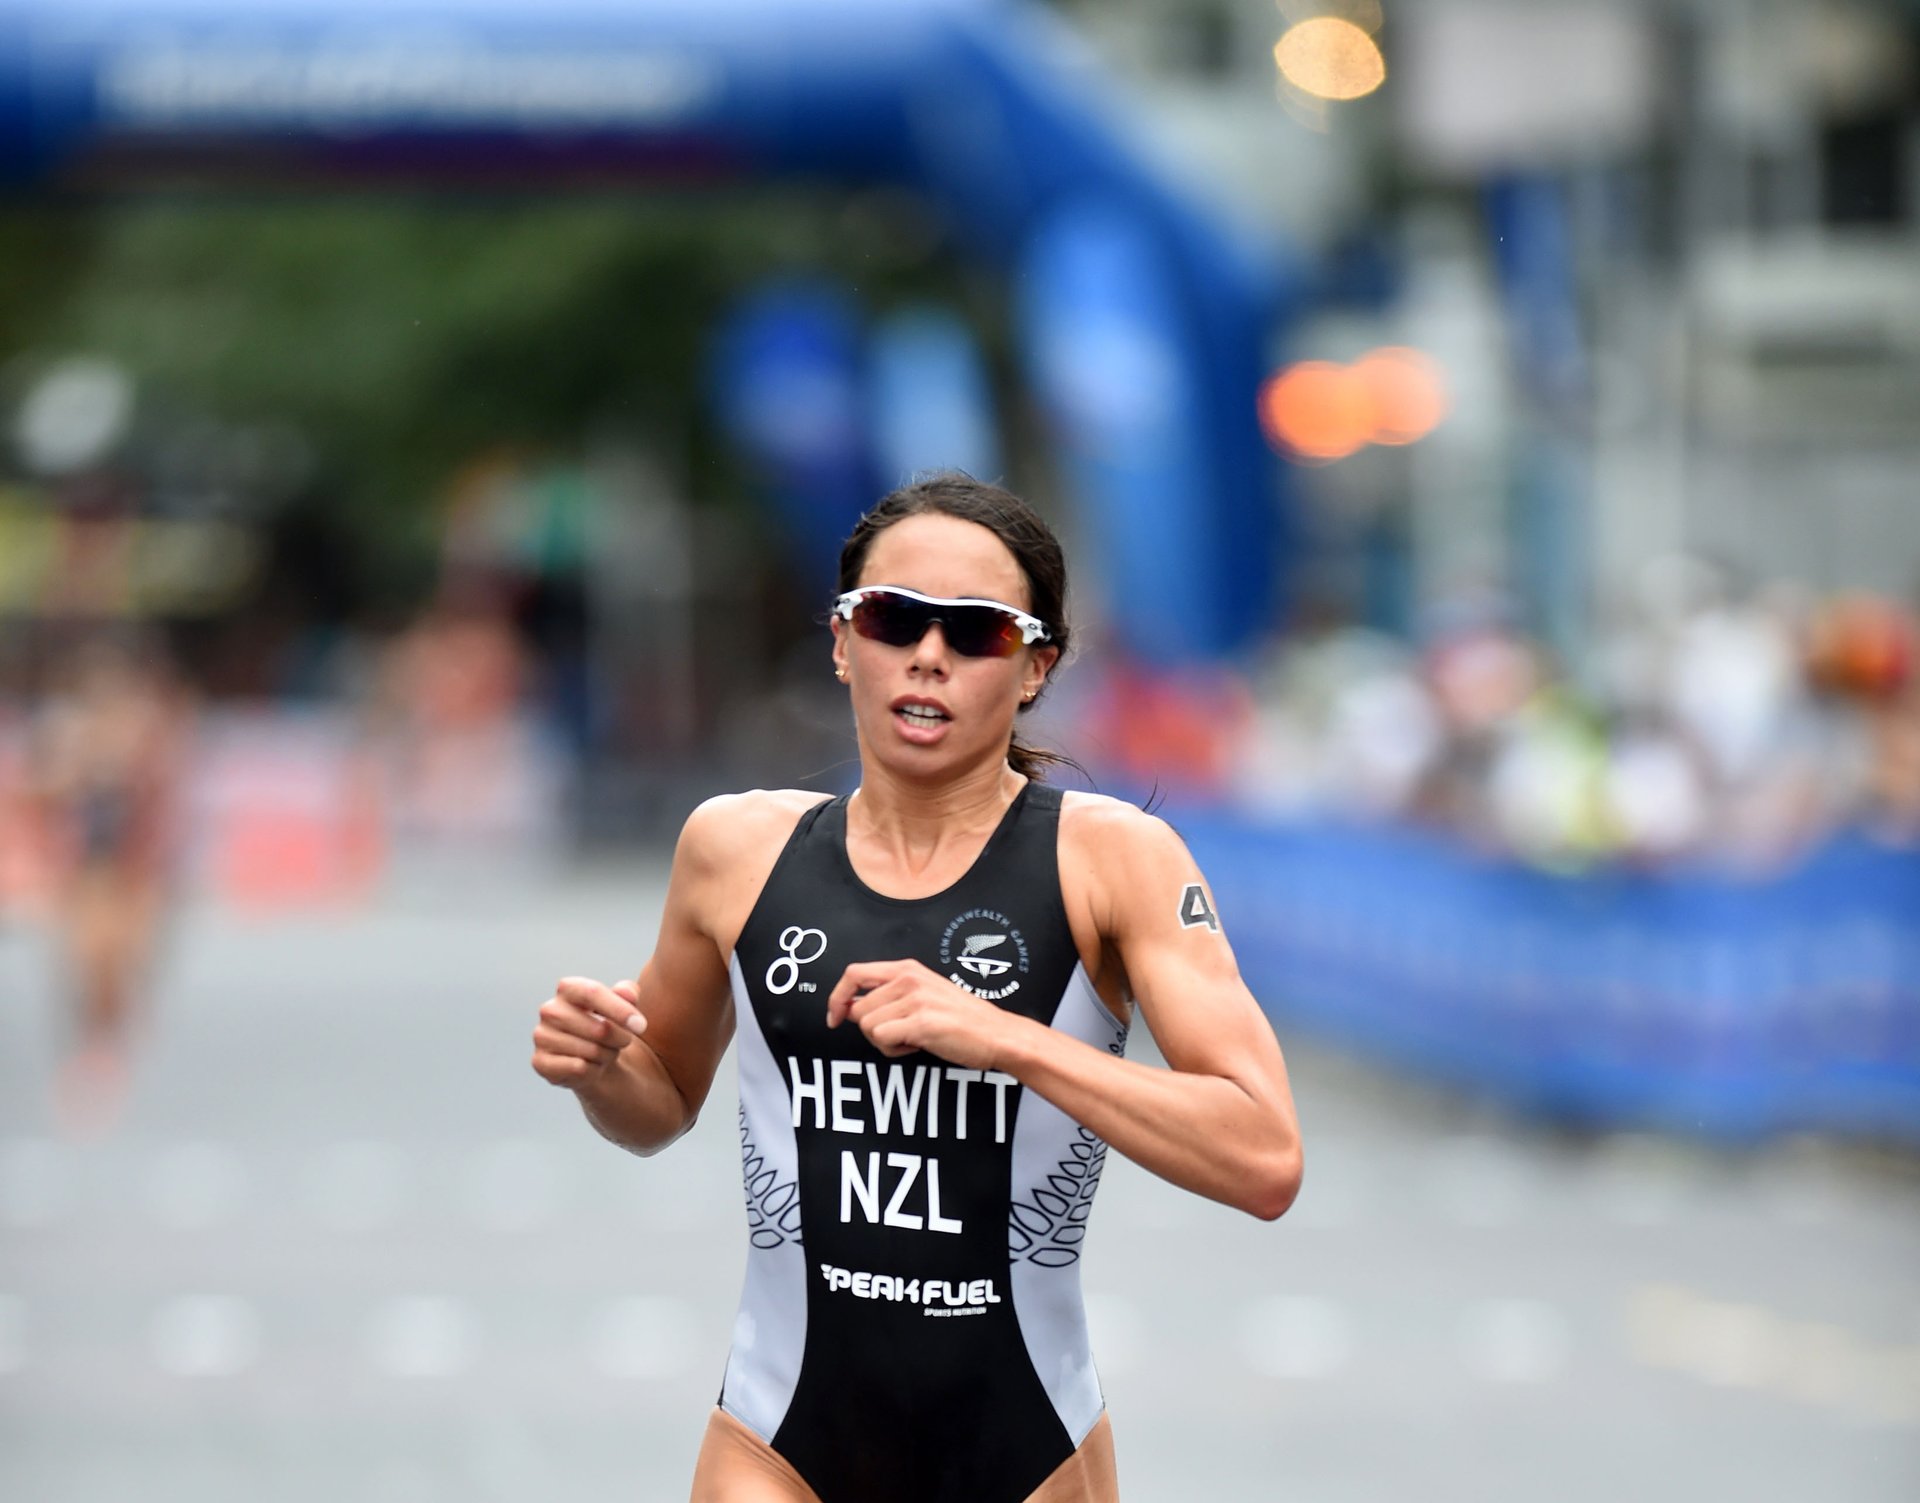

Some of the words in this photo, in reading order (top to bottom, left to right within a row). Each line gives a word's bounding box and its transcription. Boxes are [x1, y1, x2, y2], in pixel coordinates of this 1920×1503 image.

[1178, 884, 1219, 933] 4
[940, 909, 1010, 964] COMMONWEALTH
[1010, 929, 1030, 973] GAMES
[798, 982, 817, 993] ITU
[974, 980, 1020, 1000] ZEALAND
[787, 1056, 1019, 1143] HEWITT
[840, 1150, 963, 1234] NZL
